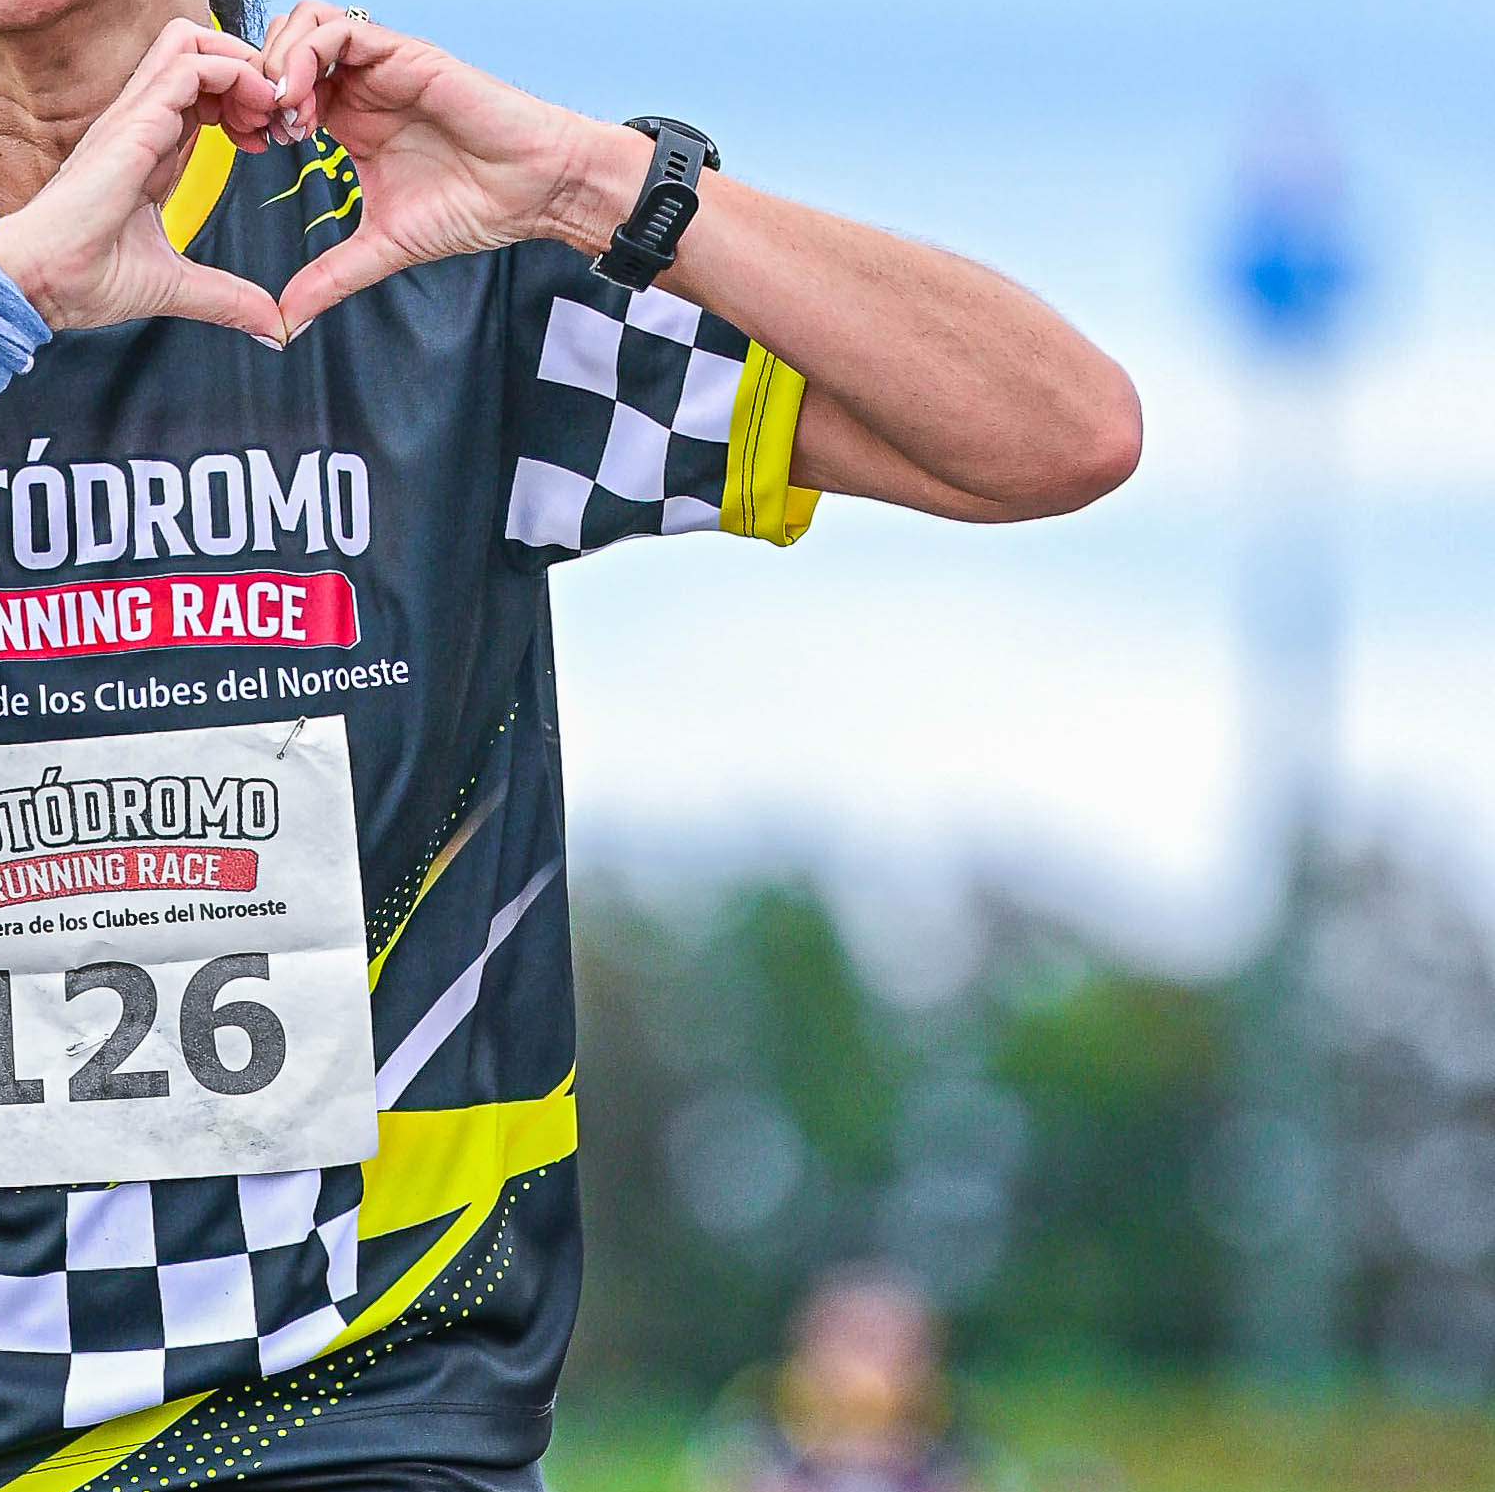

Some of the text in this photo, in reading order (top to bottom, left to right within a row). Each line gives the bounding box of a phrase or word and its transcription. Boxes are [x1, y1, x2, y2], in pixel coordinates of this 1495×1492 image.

[170, 581, 306, 641] RACE
[38, 684, 86, 715] los
[94, 677, 208, 711] Clubes
[216, 669, 269, 702] del
[277, 658, 409, 699] Noroeste
[137, 853, 222, 887] RACE
[29, 915, 54, 935] de
[59, 913, 88, 932] los
[92, 908, 160, 929] Clubes
[164, 903, 195, 924] del
[199, 899, 287, 921] Noroeste
